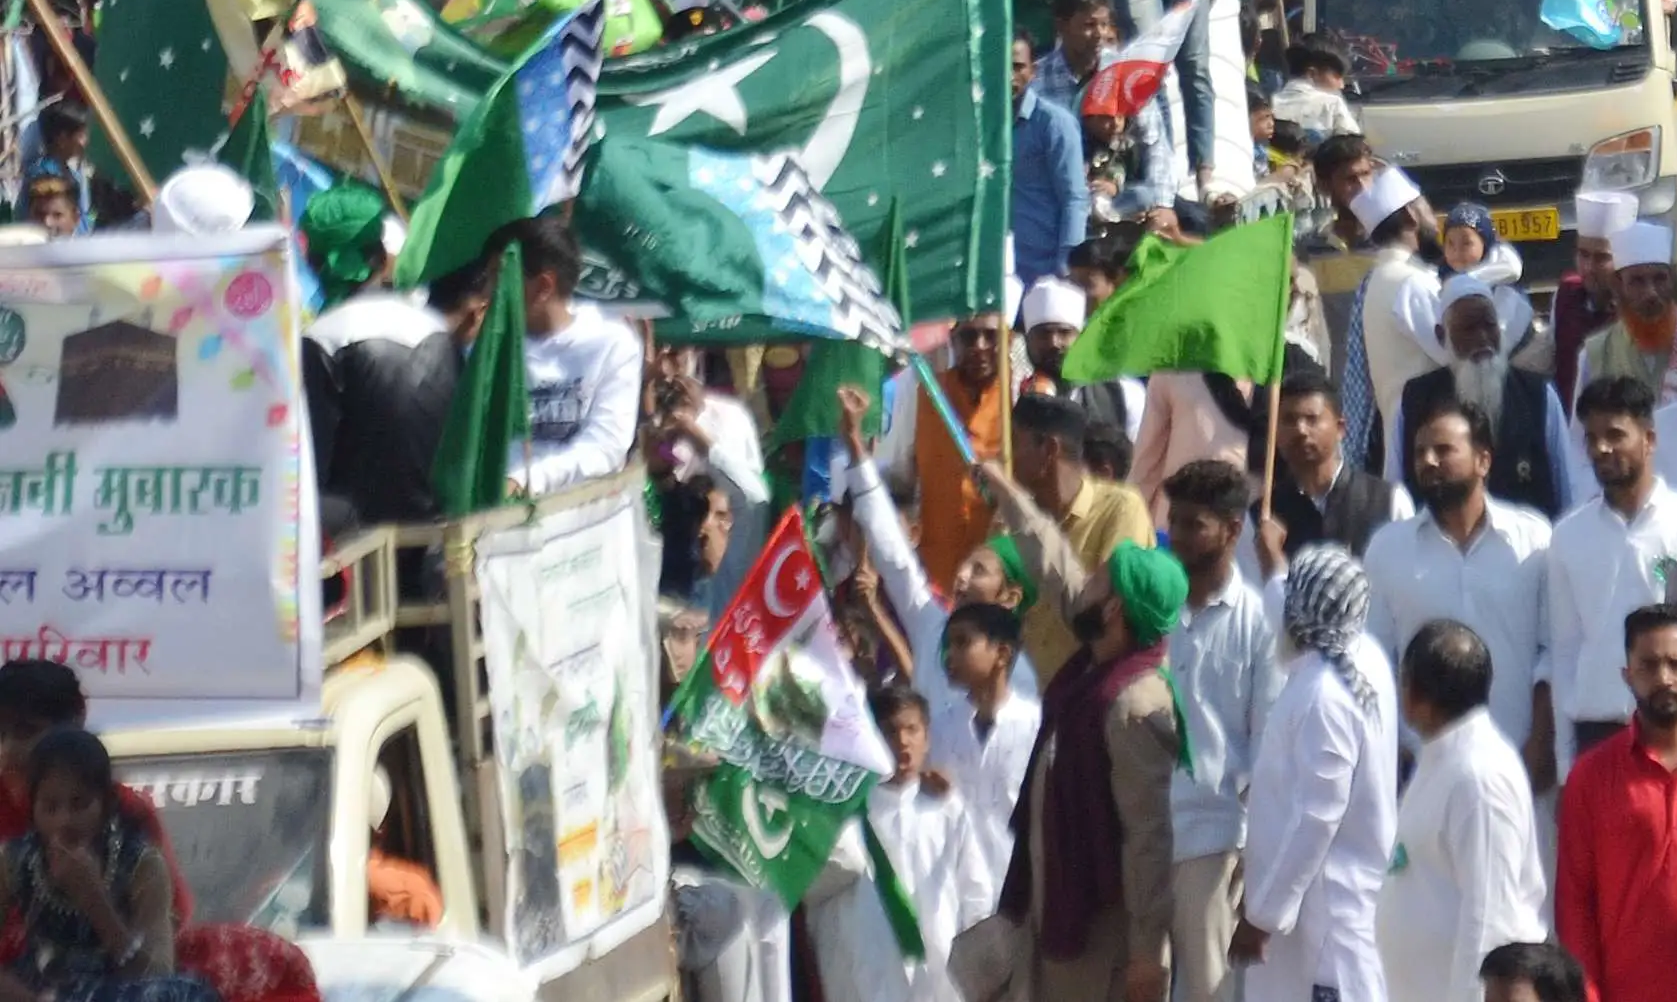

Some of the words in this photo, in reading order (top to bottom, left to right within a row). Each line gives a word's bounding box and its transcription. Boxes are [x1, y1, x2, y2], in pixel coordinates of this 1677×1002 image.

[1492, 212, 1554, 236] B1957
[93, 465, 264, 536] मुबारक
[63, 569, 213, 604] अव्वल
